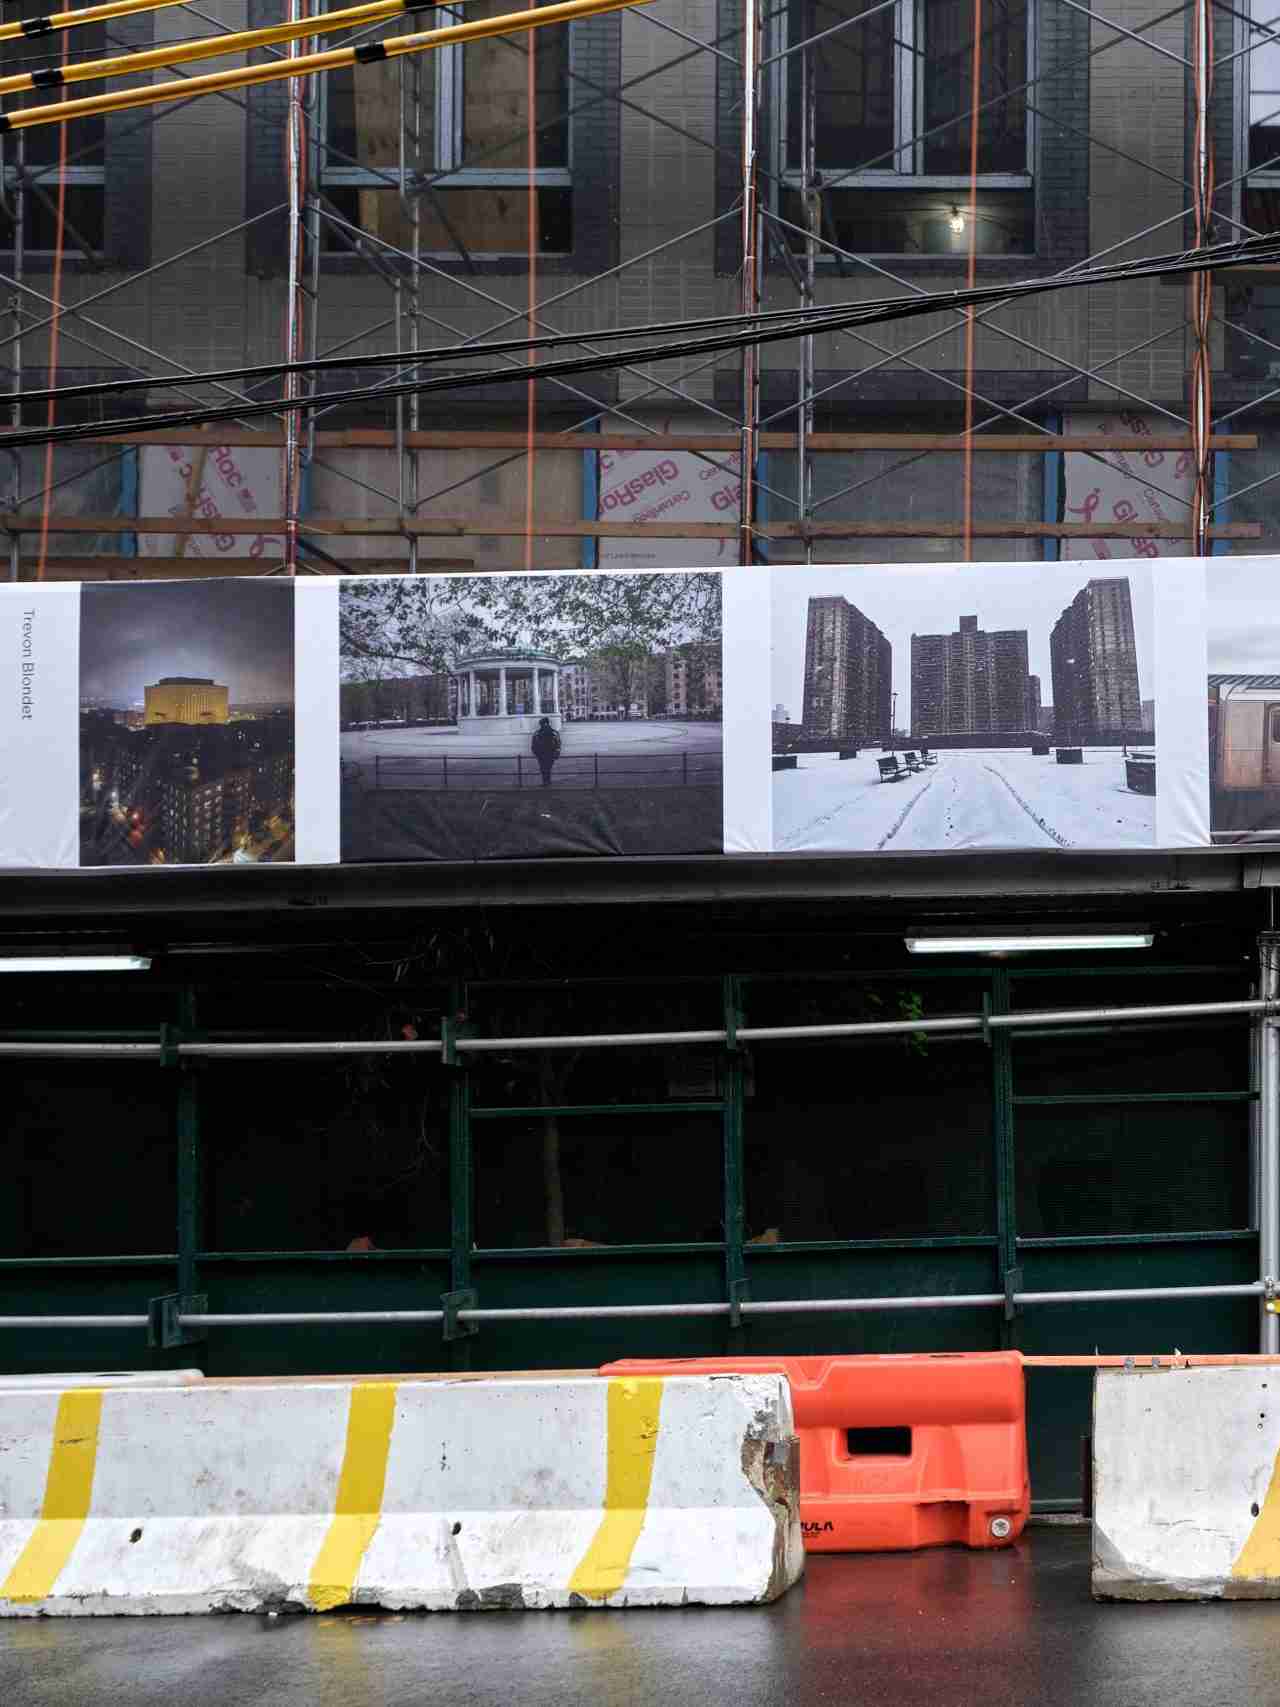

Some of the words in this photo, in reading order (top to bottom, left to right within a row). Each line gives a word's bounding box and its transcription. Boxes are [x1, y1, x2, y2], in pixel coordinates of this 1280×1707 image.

[599, 459, 680, 513] GlasRo
[22, 608, 35, 658] Trevon
[21, 662, 35, 720] Blondet
